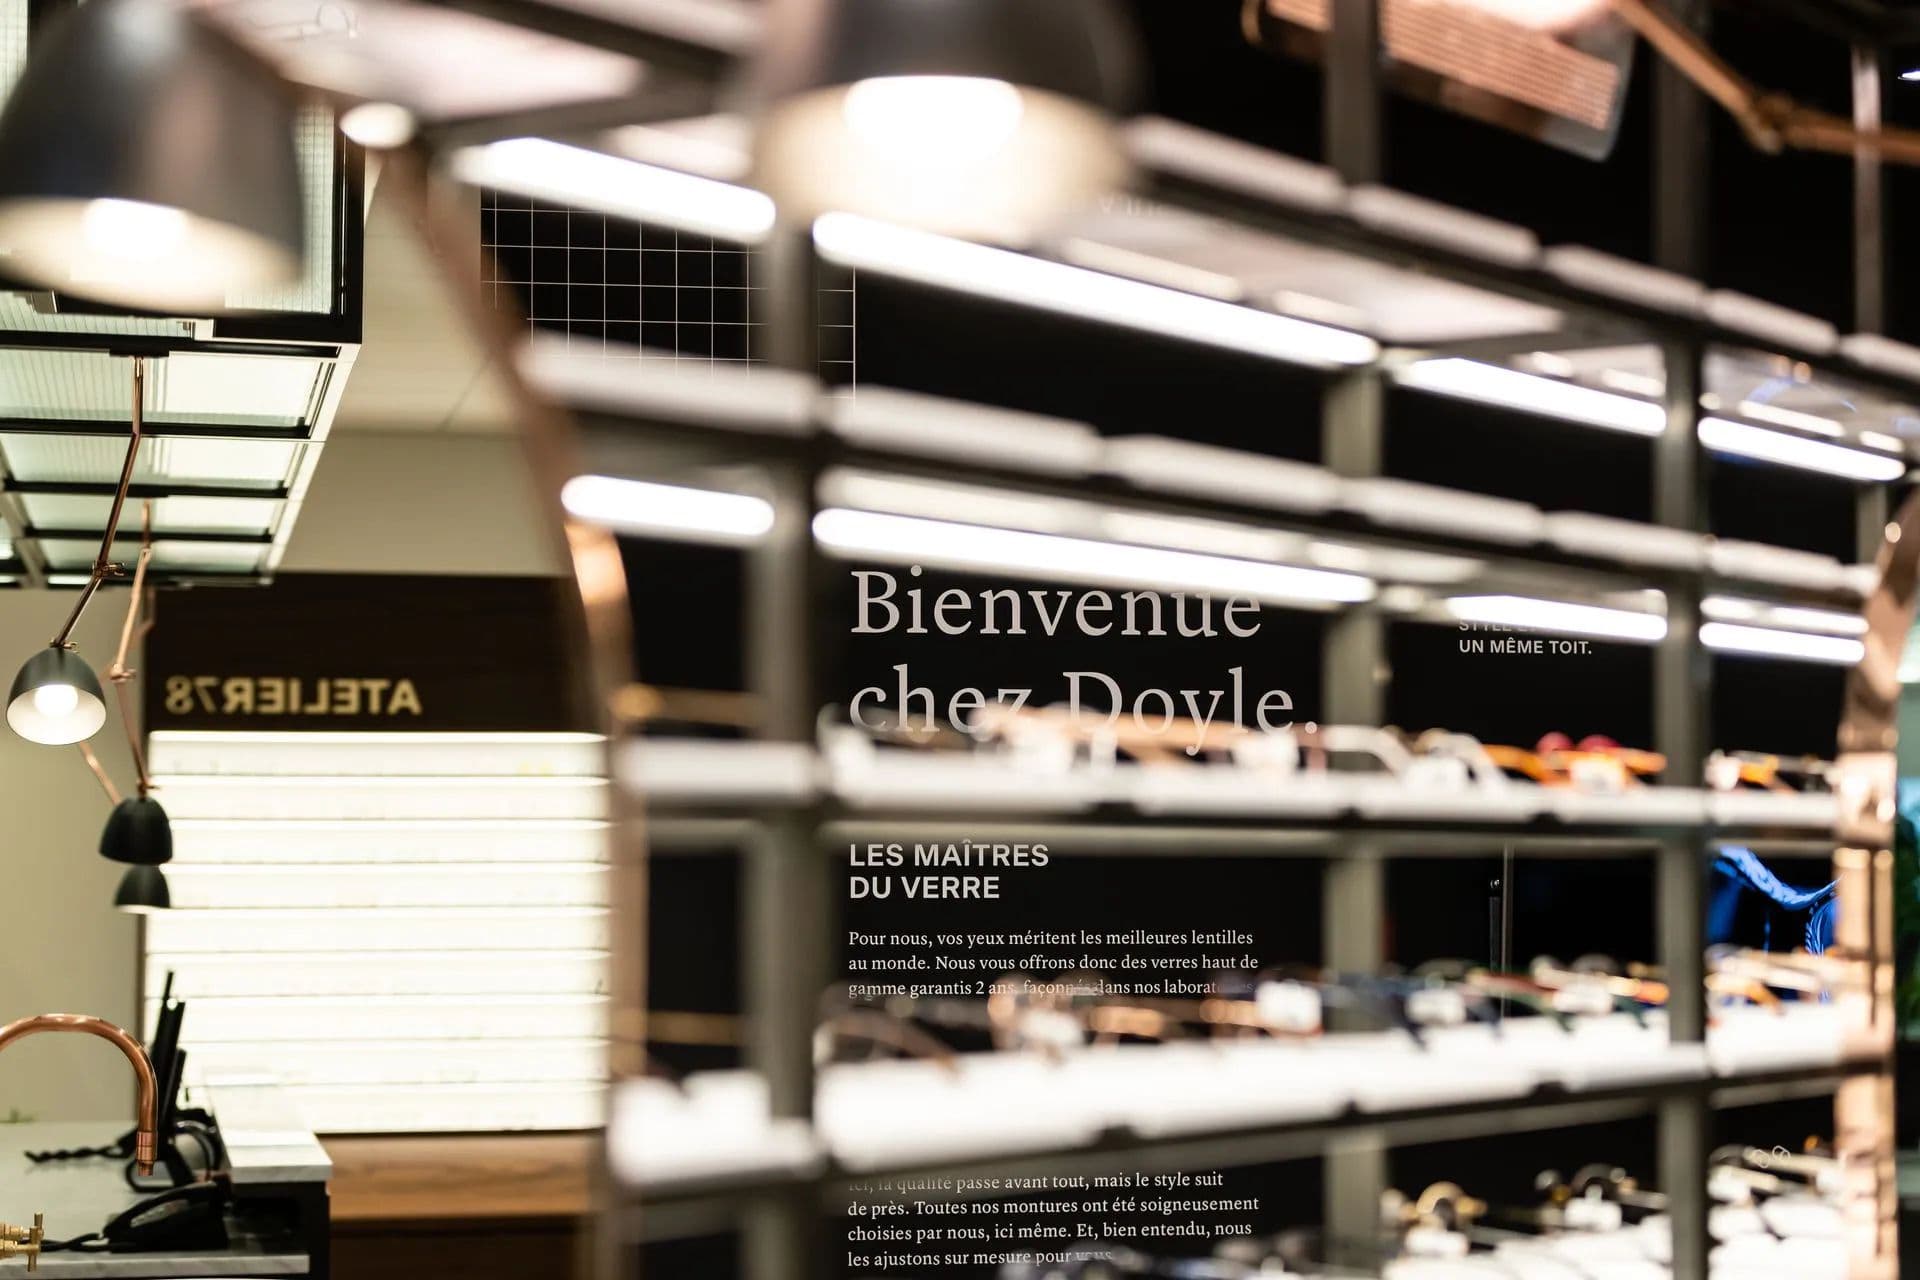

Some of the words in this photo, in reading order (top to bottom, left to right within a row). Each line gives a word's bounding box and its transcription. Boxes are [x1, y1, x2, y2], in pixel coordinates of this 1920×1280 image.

[850, 565, 1261, 637] Bienvenue
[1459, 639, 1484, 653] UN
[1490, 637, 1544, 654] MÊME
[1548, 640, 1592, 655] TOIT.
[1062, 666, 1318, 756] Doyle.
[849, 843, 904, 867] LES
[914, 838, 1049, 867] MAÎTRES
[849, 876, 892, 899] DU
[900, 876, 1000, 899] VERRE
[848, 931, 887, 946] Pour
[890, 933, 933, 948] nous,
[937, 934, 963, 946] vos
[967, 934, 1004, 949] yeux
[1008, 930, 1077, 946] méritent
[1081, 930, 1102, 945] les
[1106, 930, 1188, 945] meilleures
[1191, 930, 1254, 945] lentilles
[848, 958, 867, 970] au
[871, 955, 930, 970] monde.
[935, 956, 976, 970] Nous
[979, 958, 1015, 970] vous
[1019, 954, 1075, 970] offrons
[1079, 954, 1117, 969] donc
[1121, 954, 1147, 969] des
[1150, 957, 1198, 969] verres
[1202, 954, 1236, 969] haut
[1240, 954, 1259, 969] de
[848, 983, 906, 1000] gamme
[910, 980, 972, 999] garantis
[975, 981, 985, 995] 2
[1096, 979, 1131, 995] dans
[1134, 982, 1161, 994] nos
[896, 1175, 952, 1194] qualité
[956, 1177, 1001, 1194] passe
[1004, 1176, 1049, 1189] avant
[1053, 1175, 1090, 1190] tout,
[1094, 1172, 1131, 1187] mais
[1136, 1172, 1150, 1187] le
[1154, 1171, 1191, 1190] style
[1194, 1171, 1223, 1187] suit
[848, 1201, 867, 1216] de
[871, 1200, 909, 1220] près.
[914, 1200, 968, 1215] Toutes
[971, 1202, 1000, 1214] nos
[1003, 1200, 1078, 1214] montures
[1082, 1200, 1108, 1213] ont
[1112, 1197, 1136, 1212] été
[1140, 1196, 1259, 1215] soigneusement
[848, 1225, 912, 1241] choisies
[916, 1228, 943, 1243] par
[947, 1227, 990, 1241] nous,
[994, 1224, 1014, 1239] ici
[1018, 1223, 1071, 1239] même.
[1077, 1223, 1098, 1240] Et,
[1103, 1222, 1137, 1237] bien
[1141, 1221, 1211, 1239] entendu,
[1215, 1223, 1252, 1236] nous
[848, 1251, 869, 1266] les
[874, 1251, 940, 1270] ajustons
[944, 1253, 970, 1265] sur
[973, 1252, 1031, 1265] mesure
[1036, 1252, 1071, 1267] pour
